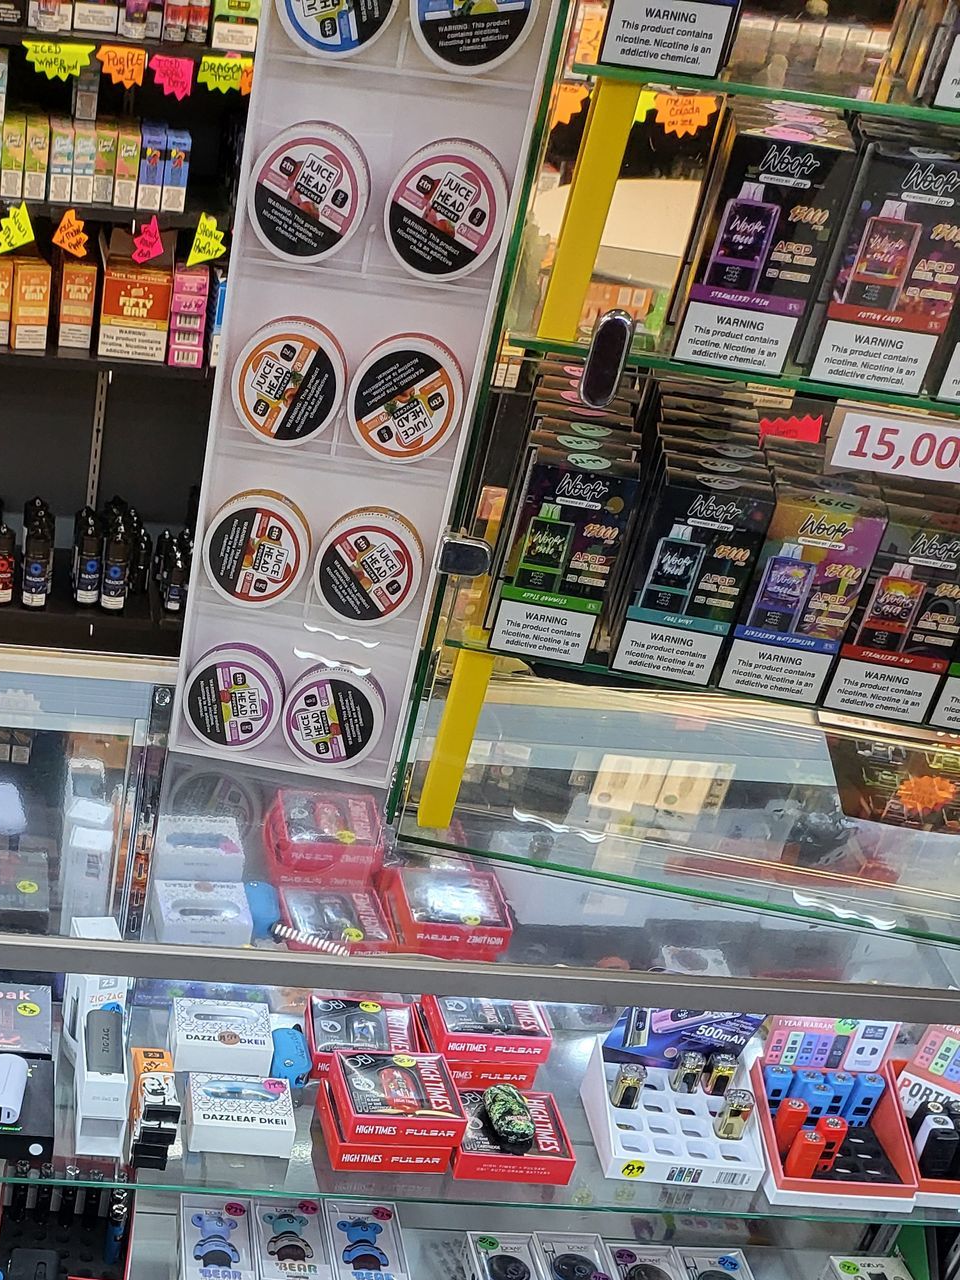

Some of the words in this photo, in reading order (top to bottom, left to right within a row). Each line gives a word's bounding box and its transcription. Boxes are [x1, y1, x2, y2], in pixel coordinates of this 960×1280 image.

[645, 8, 697, 24] WARNING
[621, 20, 639, 30] This
[640, 23, 674, 35] product
[676, 27, 713, 40] contains
[32, 44, 62, 54] ICED
[616, 34, 652, 46] nicotine.
[654, 38, 689, 51] Nicotine
[691, 43, 698, 52] is
[700, 46, 712, 54] an
[620, 48, 659, 60] addictive
[660, 52, 700, 65] chemical.
[306, 160, 335, 182] JUICE
[300, 171, 327, 195] HEAD
[444, 178, 473, 201] JUICE
[437, 190, 465, 212] HEAD
[525, 612, 568, 626] WARNING
[502, 629, 532, 640] nicotine.
[532, 633, 562, 644] Nicotine
[563, 638, 572, 647] is
[506, 620, 522, 629] This
[522, 624, 550, 633] product
[551, 627, 582, 638] contains
[505, 638, 537, 650] addictive
[538, 643, 571, 655] chemical.
[784, 1020, 802, 1028] YEAR
[696, 1024, 746, 1046] 500mAh
[202, 1112, 256, 1125] DAZZLEAF
